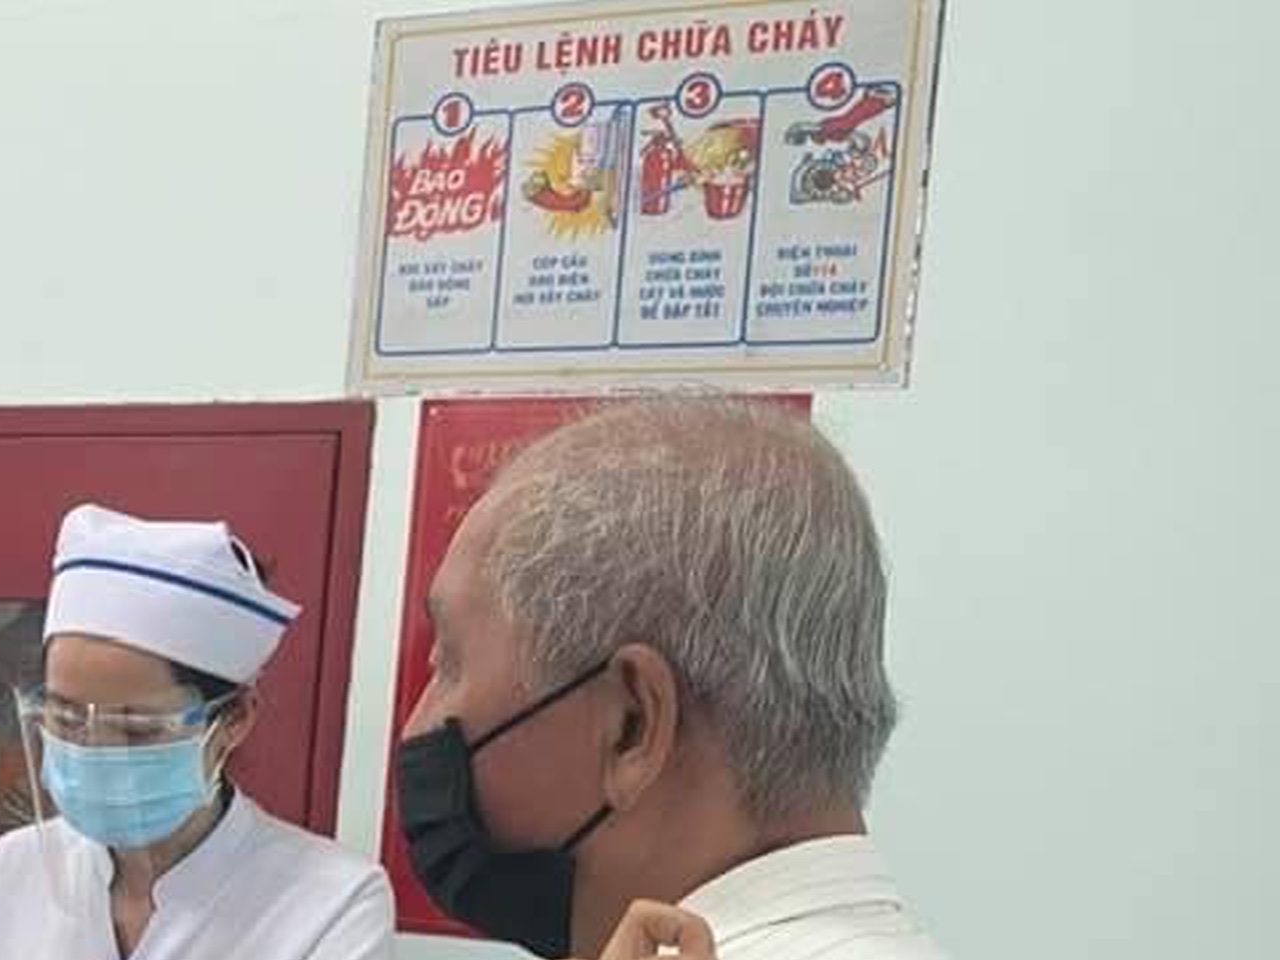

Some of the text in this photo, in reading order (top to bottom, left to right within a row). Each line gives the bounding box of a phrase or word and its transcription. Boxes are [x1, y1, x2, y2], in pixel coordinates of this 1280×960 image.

[453, 9, 844, 78] TIÊU LỆNH CHỮA CHÁY
[684, 81, 710, 109] 3
[814, 72, 846, 100] 4
[443, 100, 461, 128] 1
[560, 89, 585, 118] 2
